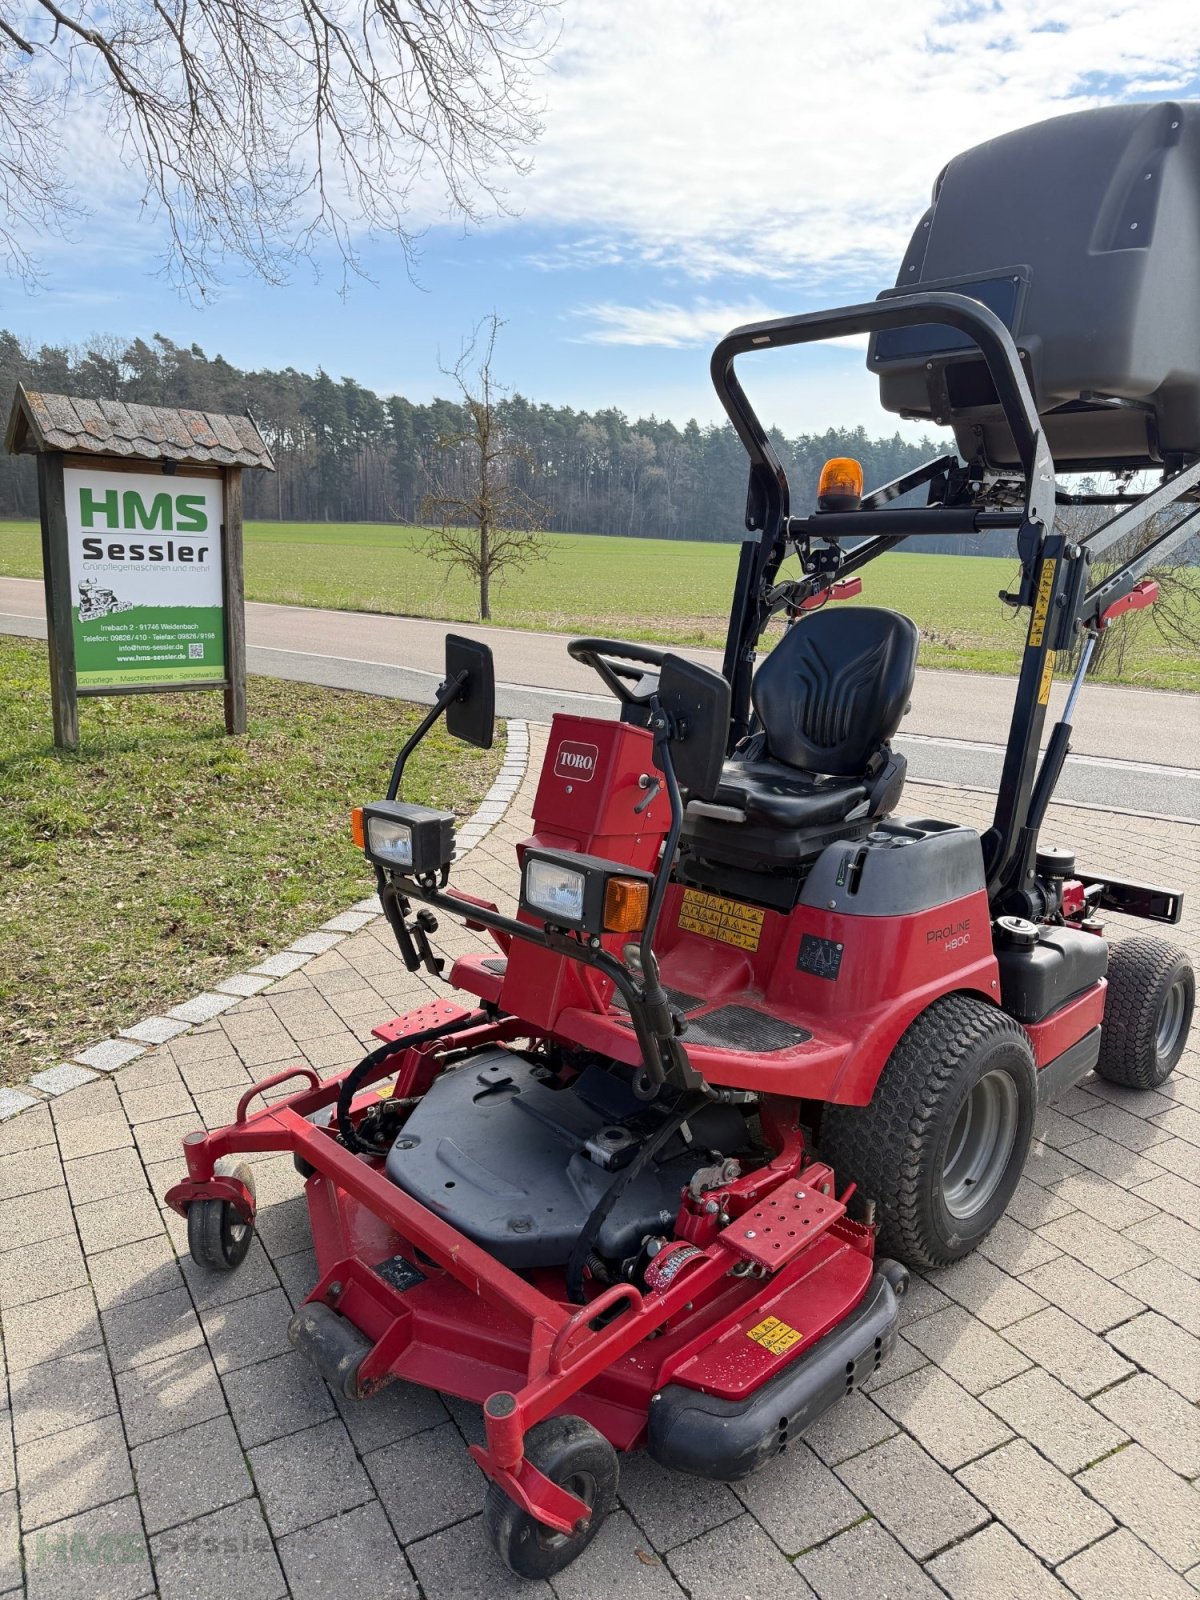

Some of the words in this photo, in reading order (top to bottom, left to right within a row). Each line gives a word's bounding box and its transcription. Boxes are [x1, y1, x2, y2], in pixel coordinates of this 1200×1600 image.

[79, 487, 208, 532] HMS
[82, 538, 209, 563] Sessler
[172, 564, 188, 573] und
[161, 623, 199, 631] Weidenbach
[152, 633, 177, 641] Telefax:
[118, 643, 184, 652] info@hms-sessler.de
[116, 652, 187, 662] www.hms-sessler.de
[120, 673, 174, 683] Maschinenhandel
[560, 751, 593, 770] TORO
